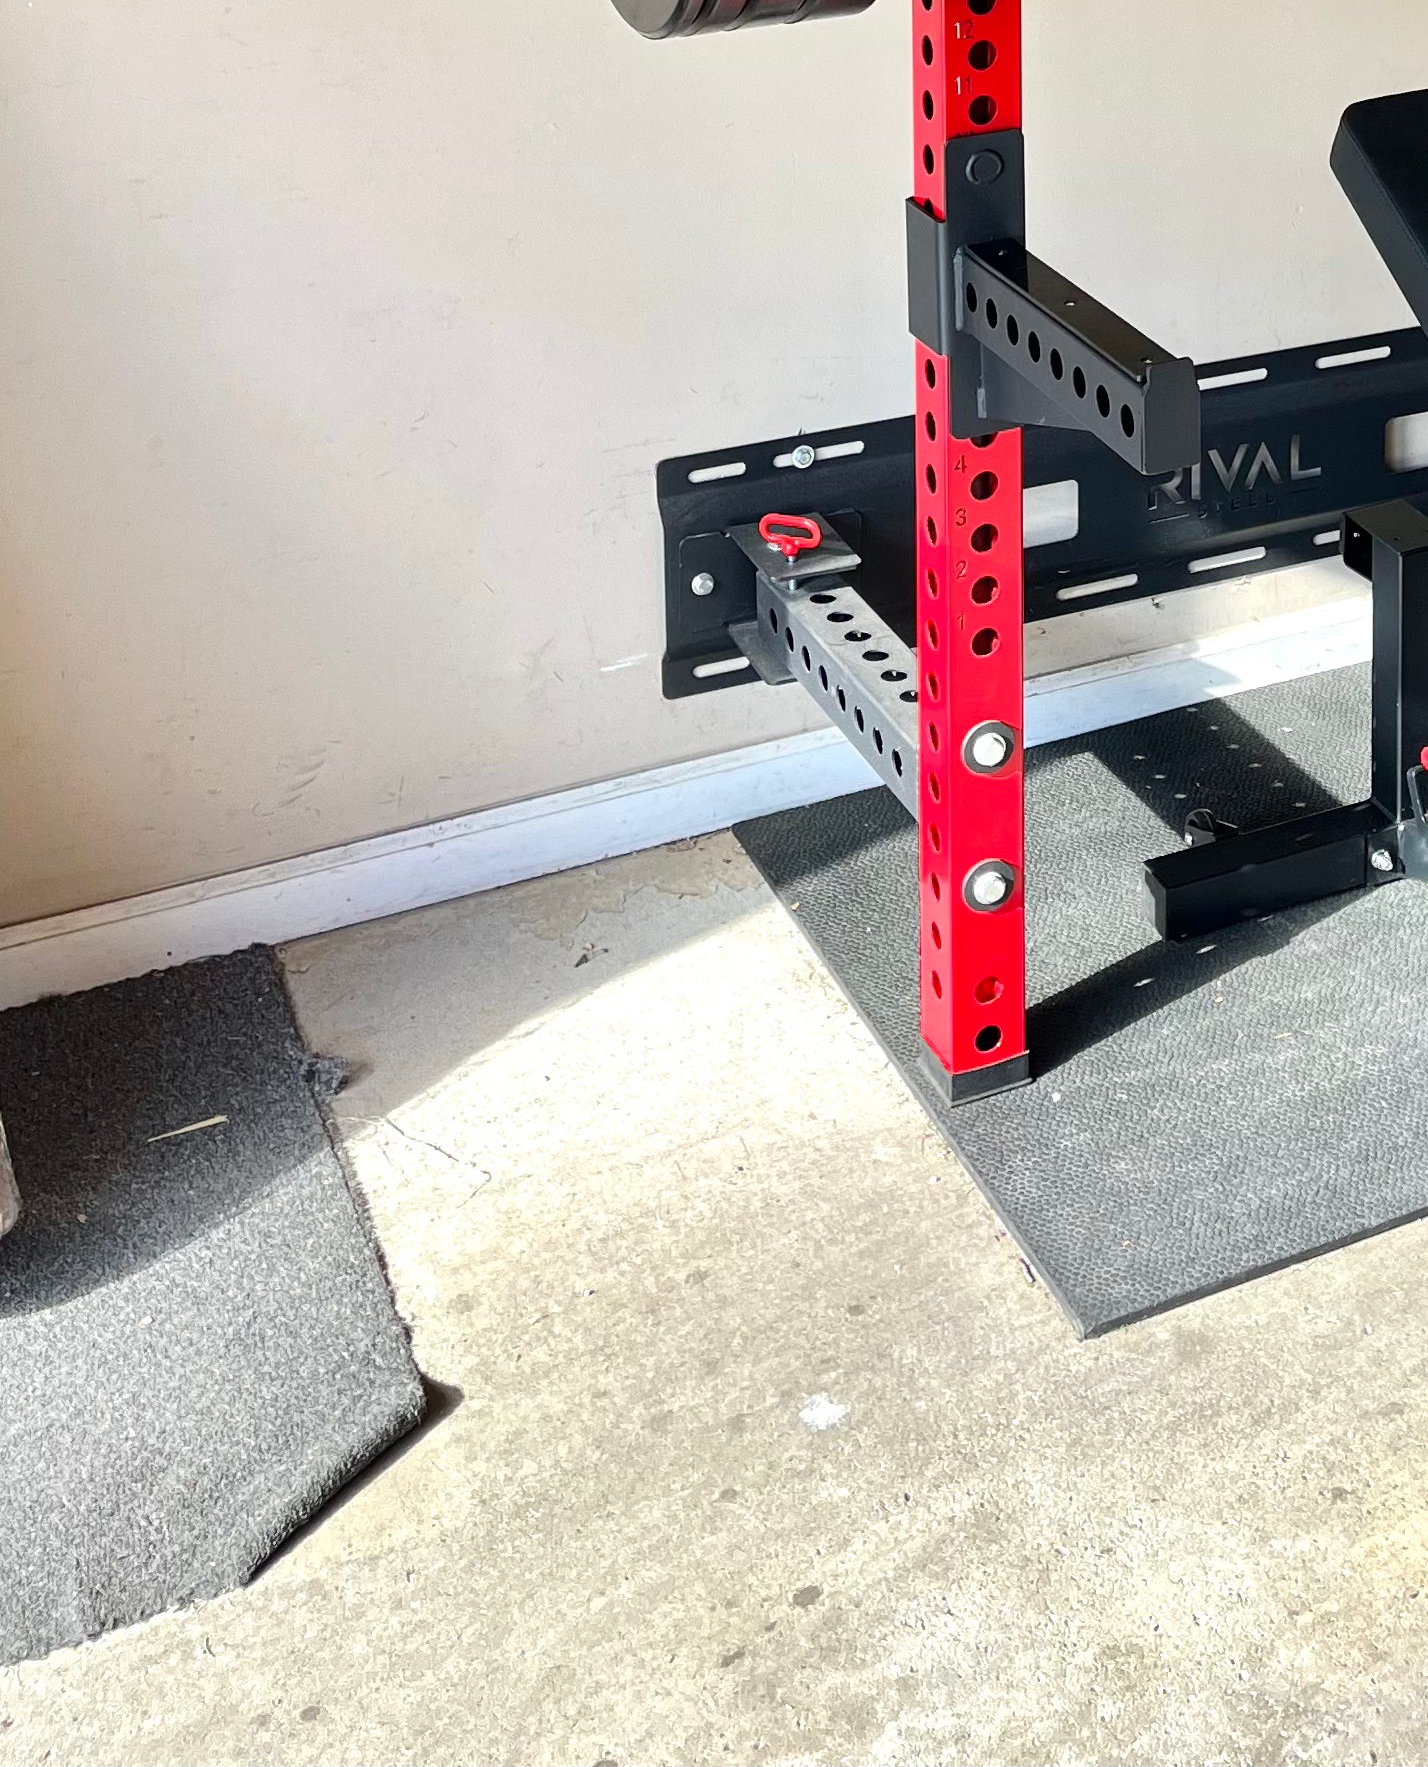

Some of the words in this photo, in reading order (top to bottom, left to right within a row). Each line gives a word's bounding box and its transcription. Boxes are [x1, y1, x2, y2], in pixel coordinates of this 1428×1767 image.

[953, 18, 974, 40] 12
[953, 75, 972, 95] 11
[954, 455, 967, 474] 4
[1147, 434, 1322, 511] RIVAL
[955, 507, 967, 526] 3
[955, 560, 967, 579] 2
[956, 612, 966, 630] 1
